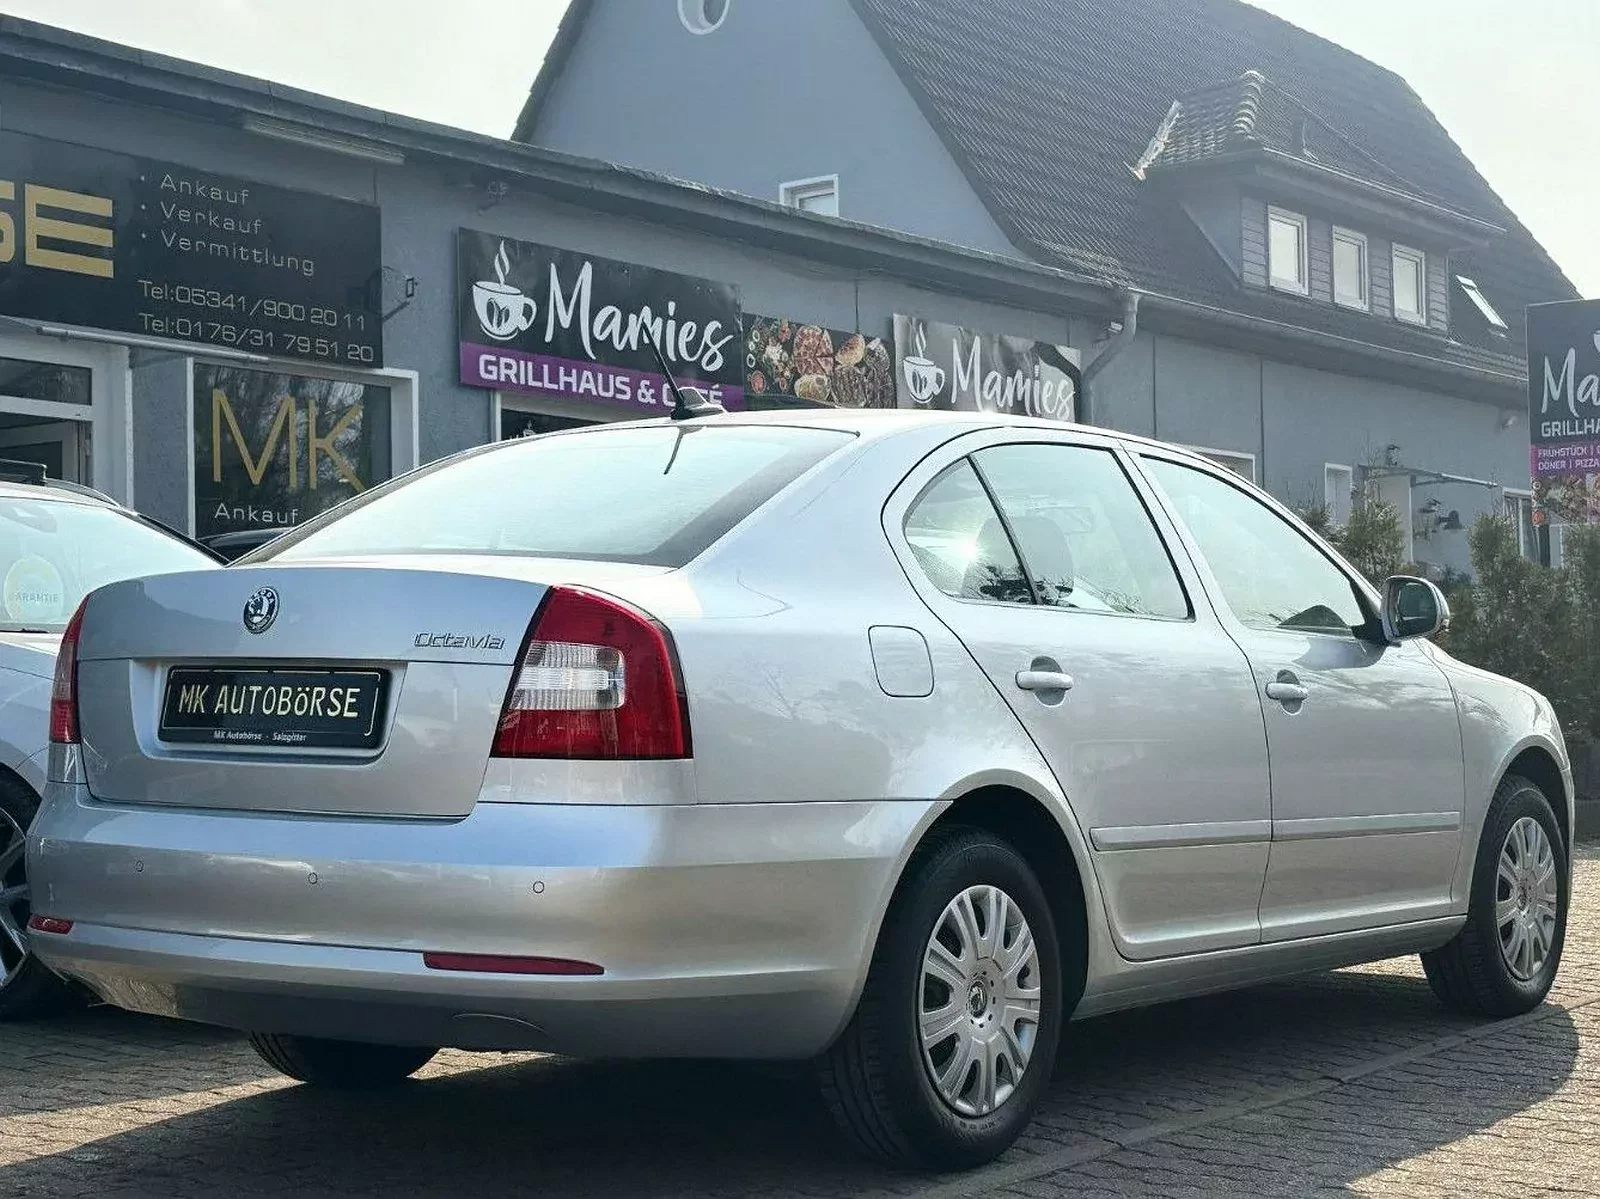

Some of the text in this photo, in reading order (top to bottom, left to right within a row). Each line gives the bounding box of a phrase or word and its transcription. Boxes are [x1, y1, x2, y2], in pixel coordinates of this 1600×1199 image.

[161, 173, 250, 206] Ankauf
[0, 180, 114, 278] E
[160, 201, 264, 236] Verkauf
[160, 229, 315, 276] Vermittlung
[544, 261, 734, 371] Mamies
[478, 354, 723, 408] GRILLHAUS & CÉ
[951, 335, 1076, 421] Mamies
[212, 387, 366, 492] MK
[214, 502, 301, 525] Ankauf
[178, 684, 209, 714] MK
